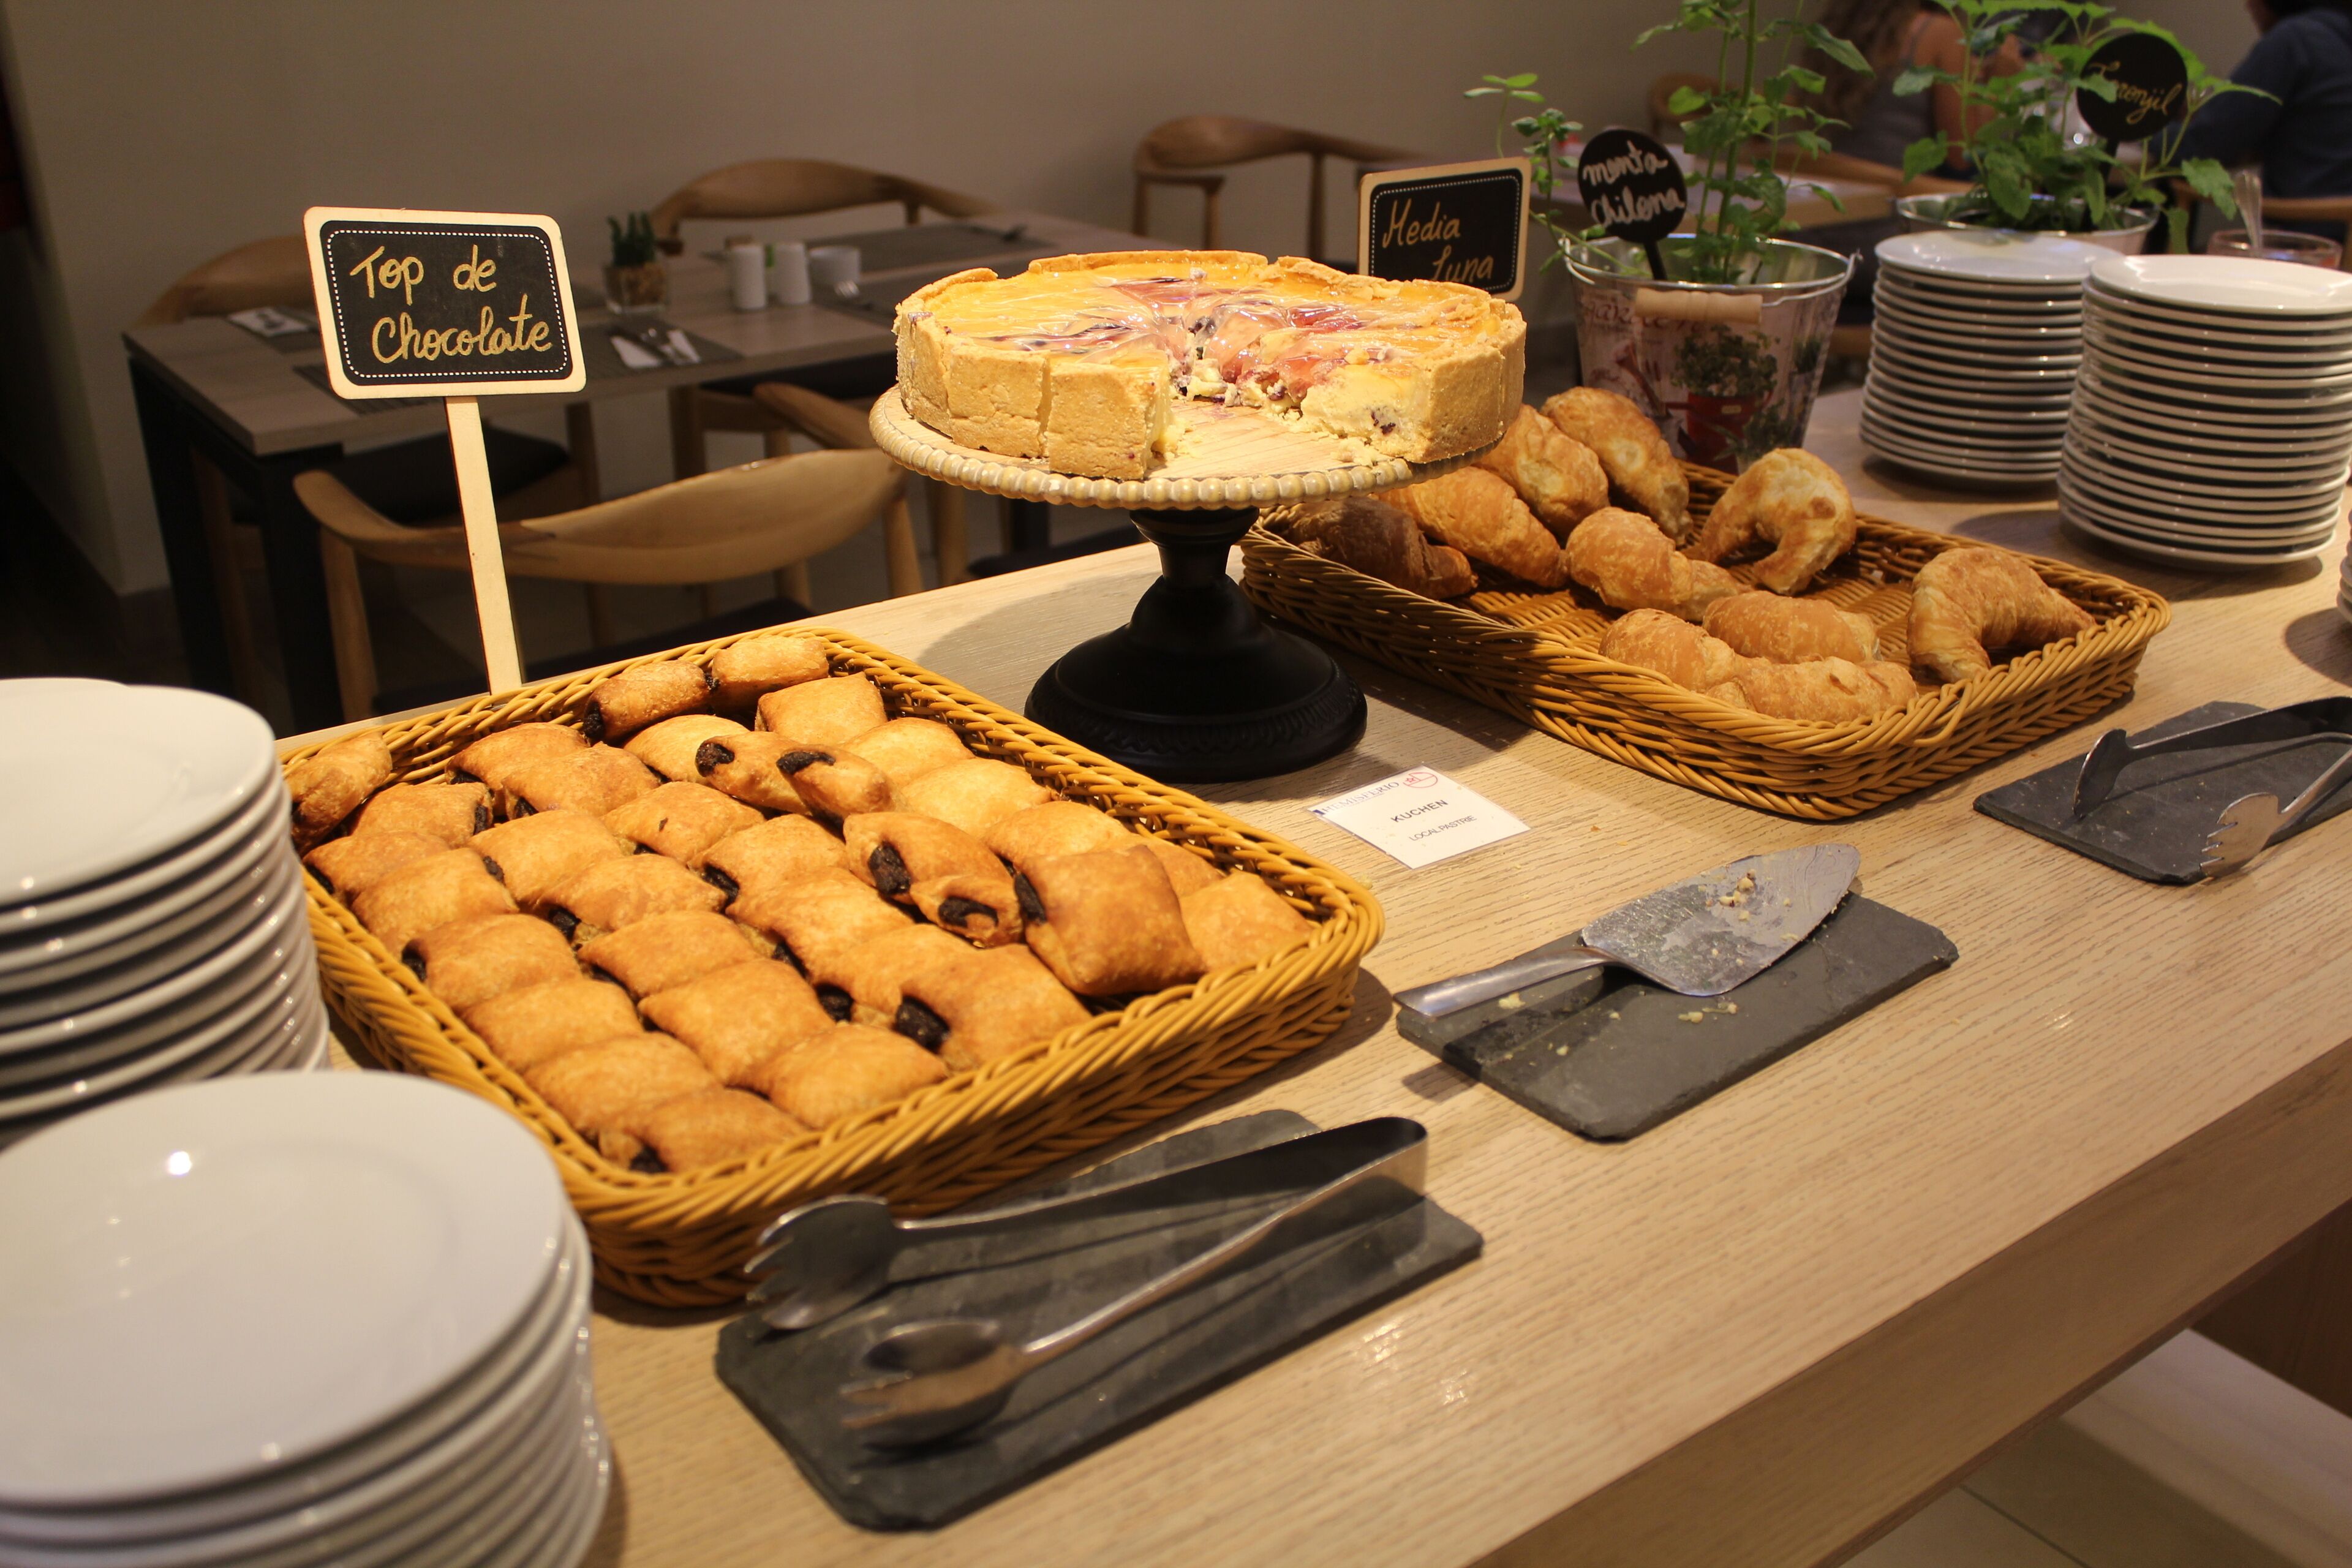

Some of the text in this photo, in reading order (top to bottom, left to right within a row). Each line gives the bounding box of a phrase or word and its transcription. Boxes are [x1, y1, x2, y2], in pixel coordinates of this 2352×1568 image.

[1382, 198, 1461, 249] Media
[349, 244, 497, 306] Top de
[371, 293, 554, 364] Chocolate
[1322, 781, 1400, 813] HEMISFERIO
[1390, 799, 1449, 823] KUCHEN
[1409, 815, 1478, 842] LOCAL PASTRIE
